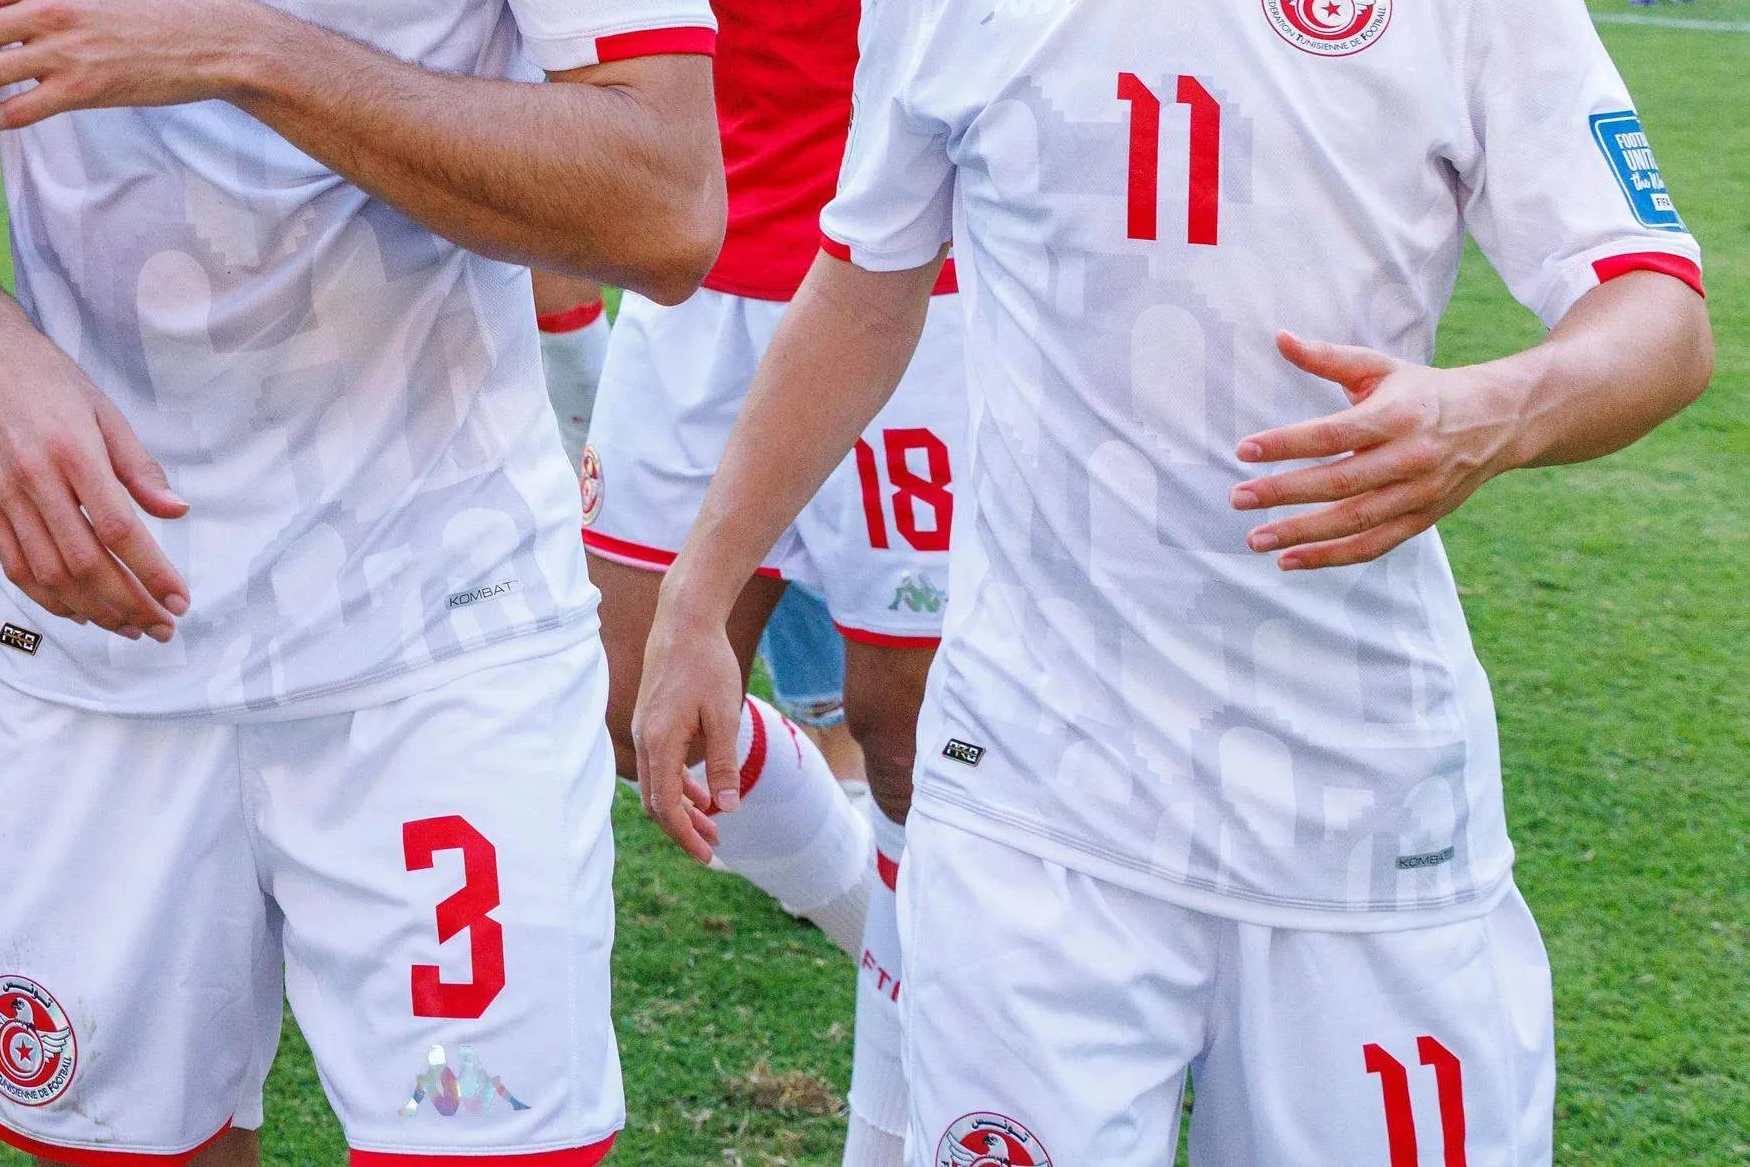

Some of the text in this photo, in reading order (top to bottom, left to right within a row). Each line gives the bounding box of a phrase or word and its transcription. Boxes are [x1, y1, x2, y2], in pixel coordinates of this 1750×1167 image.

[1296, 33, 1349, 51] TUNISIENNE
[1350, 38, 1362, 47] DE
[1117, 72, 1221, 246] 11
[852, 428, 953, 551] 18
[449, 581, 514, 608] KOMBAT
[402, 815, 505, 1019] 3
[1362, 1035, 1467, 1167] 11
